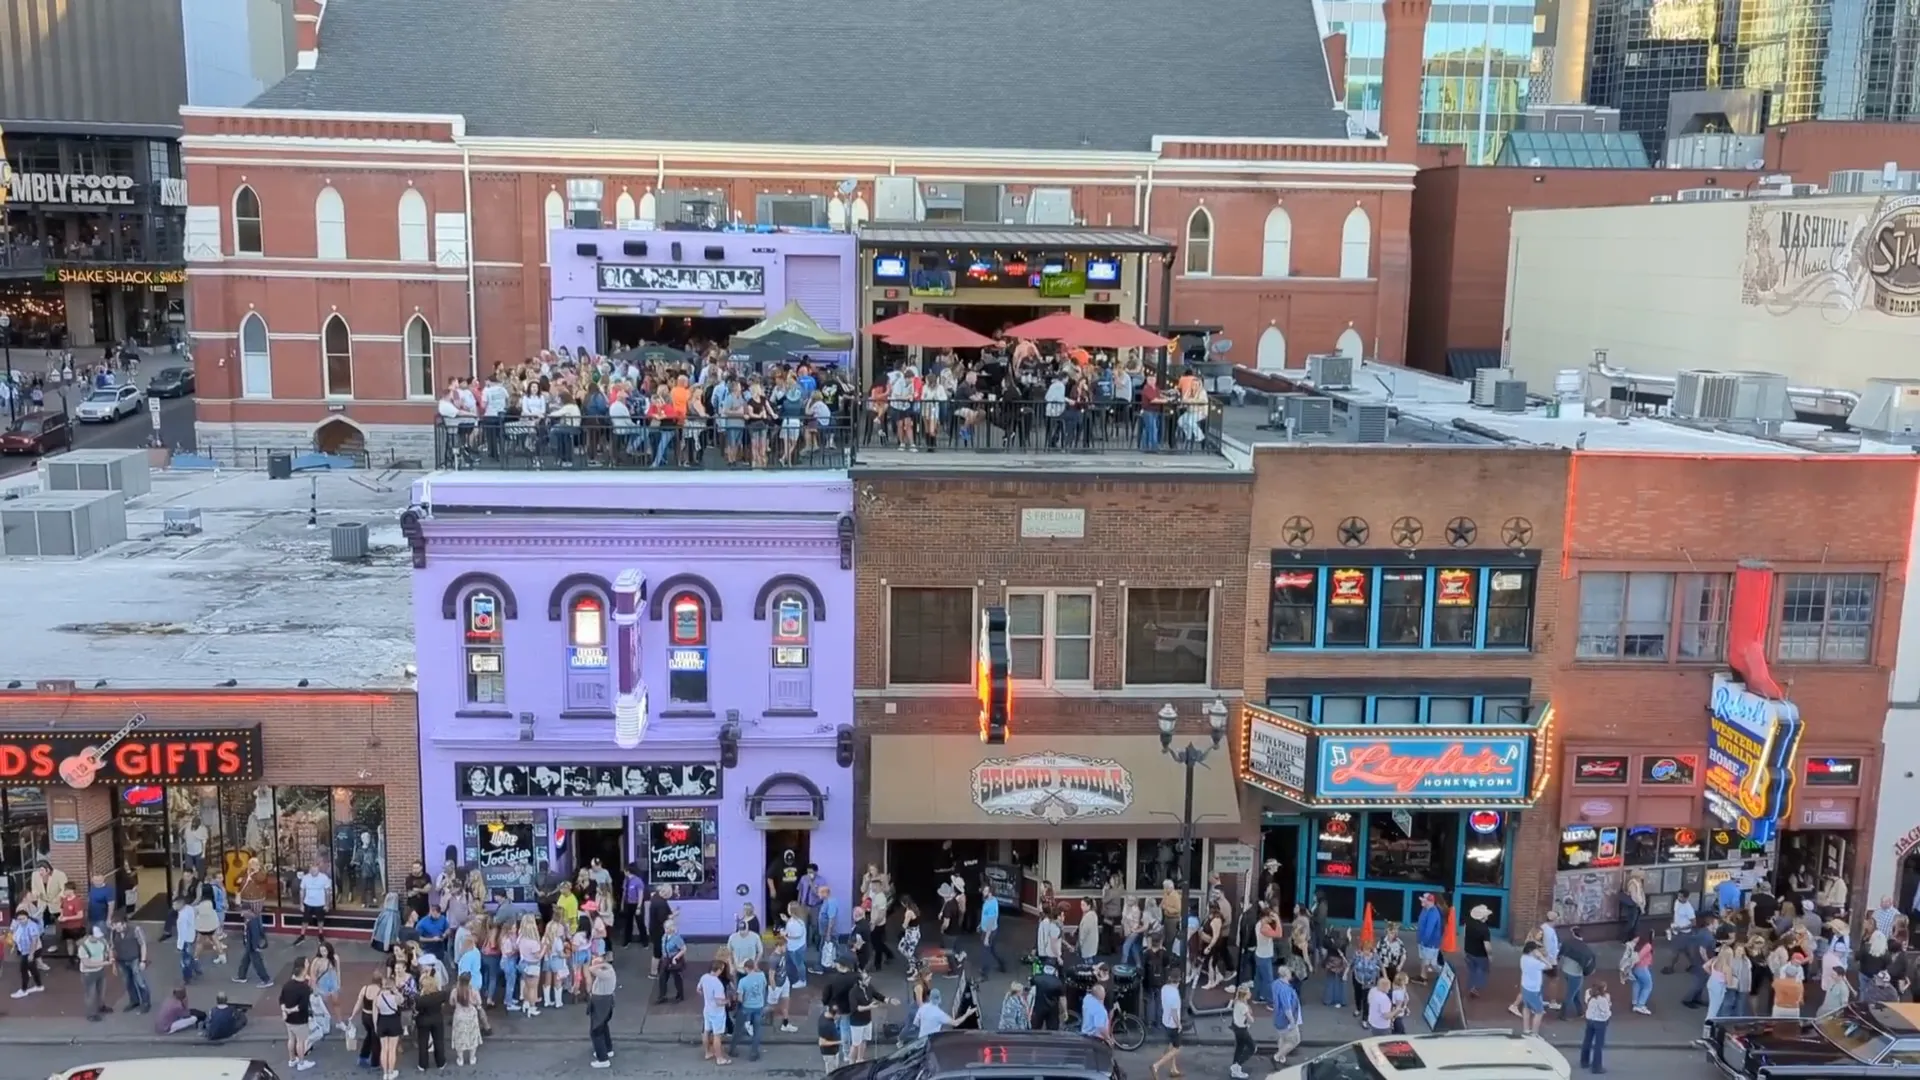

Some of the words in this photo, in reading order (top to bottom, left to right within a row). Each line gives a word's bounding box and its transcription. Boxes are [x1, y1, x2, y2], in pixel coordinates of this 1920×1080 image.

[8, 172, 70, 203] MBLY
[71, 175, 134, 189] FOOD
[71, 190, 135, 204] HALL
[1779, 211, 1849, 248] NASHVILLE
[1872, 220, 1920, 273] STA
[58, 269, 103, 283] SHAKE
[105, 270, 153, 284] SHACK
[1783, 247, 1828, 287] Music
[1035, 511, 1082, 521] FRIEDMAN
[1711, 717, 1761, 756] WESTERN
[1717, 734, 1753, 765] WORLD
[0, 744, 54, 776] DS
[115, 741, 240, 775] GIFTS
[1332, 743, 1514, 792] Layla's
[1709, 748, 1739, 776] HOME
[980, 769, 1052, 803] SECOND
[1058, 769, 1125, 803] FIDDLE
[1424, 777, 1468, 788] HONKY
[1478, 777, 1513, 787] TONK
[1563, 828, 1597, 842] ULTRA
[481, 848, 531, 867] Tootsies
[652, 845, 701, 864] Tootsies
[1327, 863, 1352, 874] OPEN
